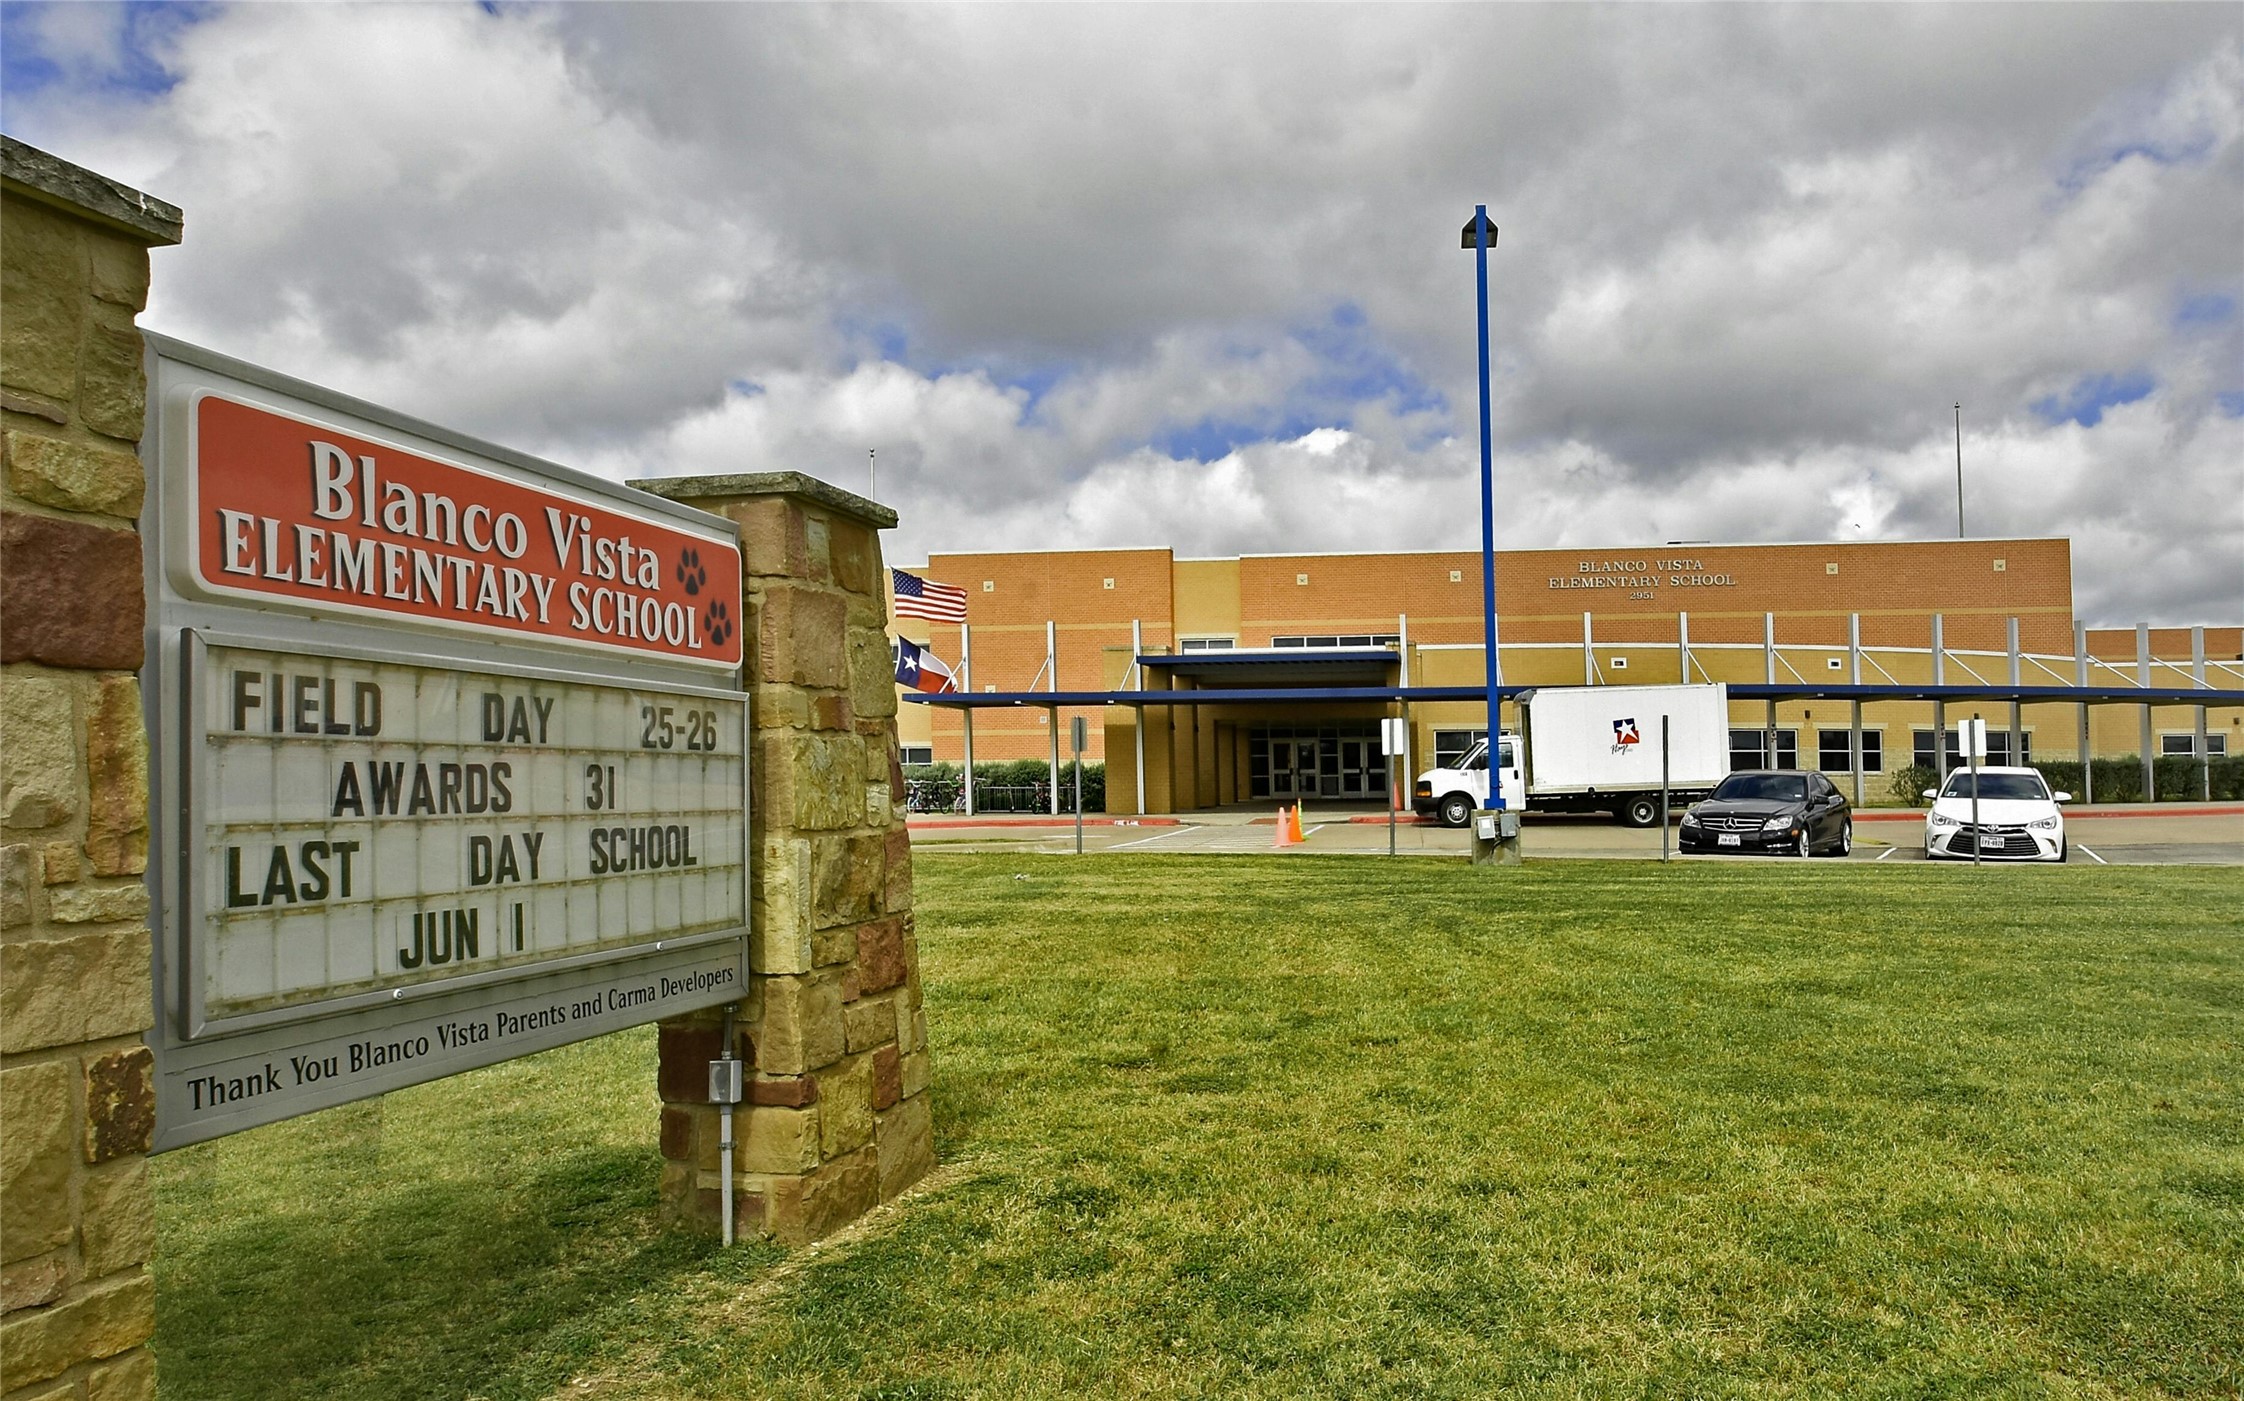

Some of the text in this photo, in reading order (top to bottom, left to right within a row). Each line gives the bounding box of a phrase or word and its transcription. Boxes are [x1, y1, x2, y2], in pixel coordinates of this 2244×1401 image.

[308, 440, 661, 590] Blanco Vista
[219, 508, 702, 649] ELEMENTARY SCHOOL
[1548, 574, 1736, 589] ELEMENTARY SCHOOL
[1579, 559, 1704, 573] BLANCO VISTA
[1629, 591, 1654, 600] 2951
[233, 670, 717, 751] FIELD DAY 25-26
[332, 761, 616, 817] AWARDS 31
[227, 825, 697, 907] LAST DAY SCHOOL
[400, 908, 479, 968] JUN
[187, 965, 734, 1112] Thank You Blanco Vista Parents and Carma Developers
